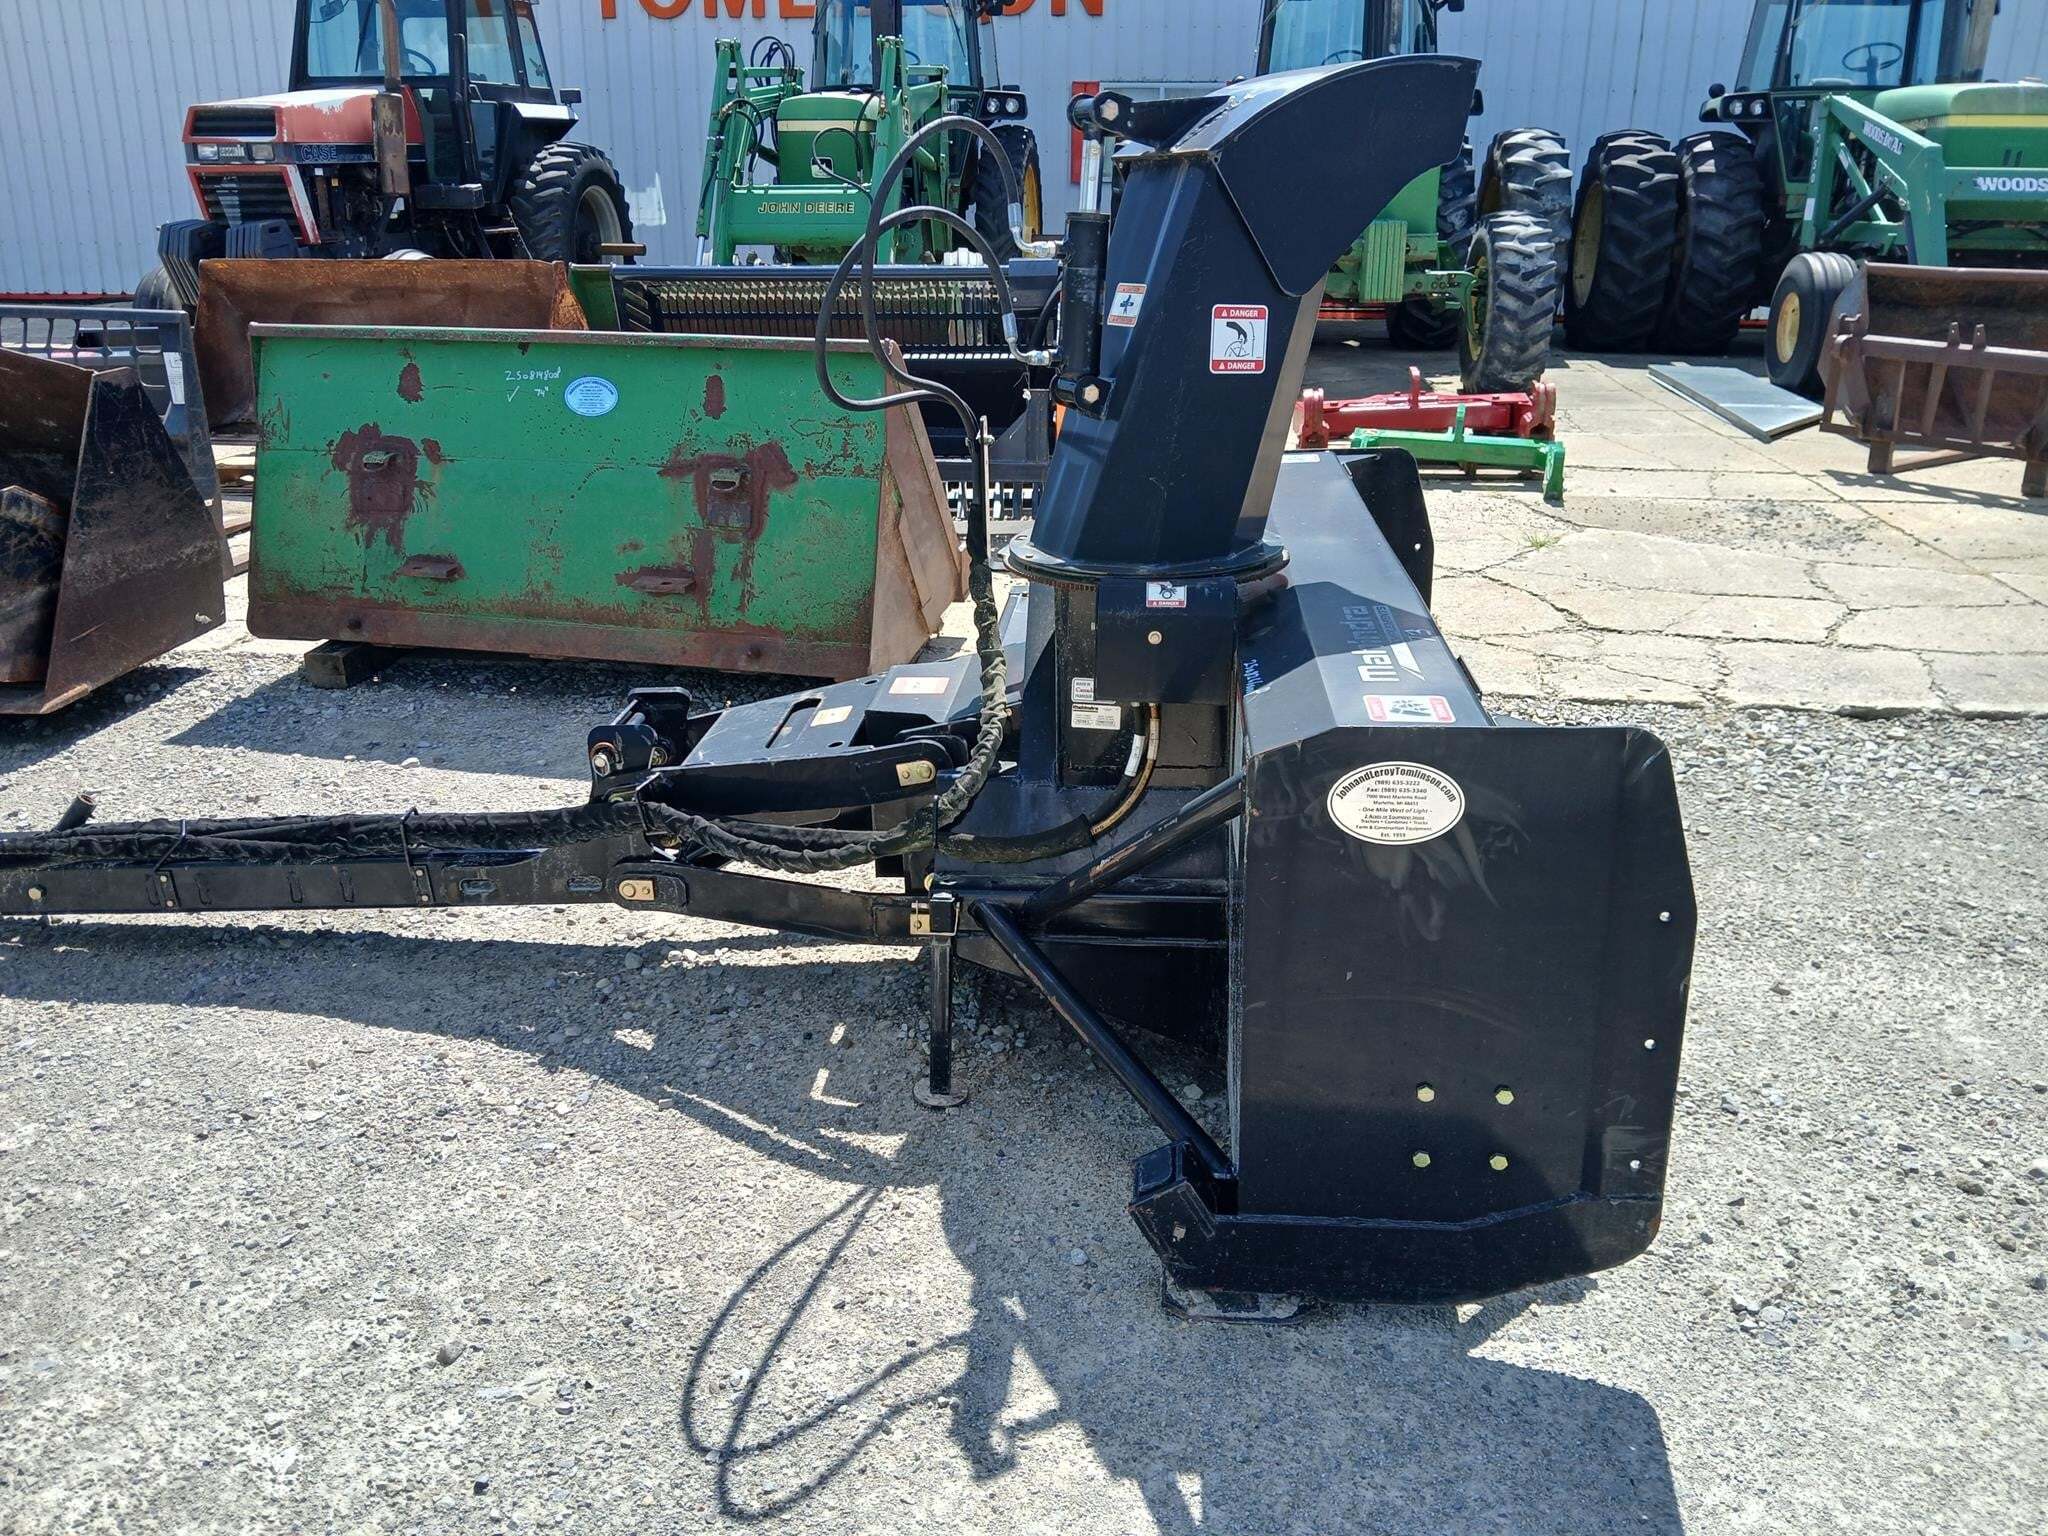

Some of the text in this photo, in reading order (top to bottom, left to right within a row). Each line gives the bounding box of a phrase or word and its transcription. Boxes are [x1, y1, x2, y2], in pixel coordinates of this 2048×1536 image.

[300, 144, 338, 162] CASE
[1977, 176, 2048, 192] WOODS
[758, 202, 855, 214] JOHN DEERE
[1229, 308, 1258, 318] DANGER
[1227, 361, 1256, 370] DANGER
[1336, 766, 1456, 802] JohnandLeroyTomlinson.com
